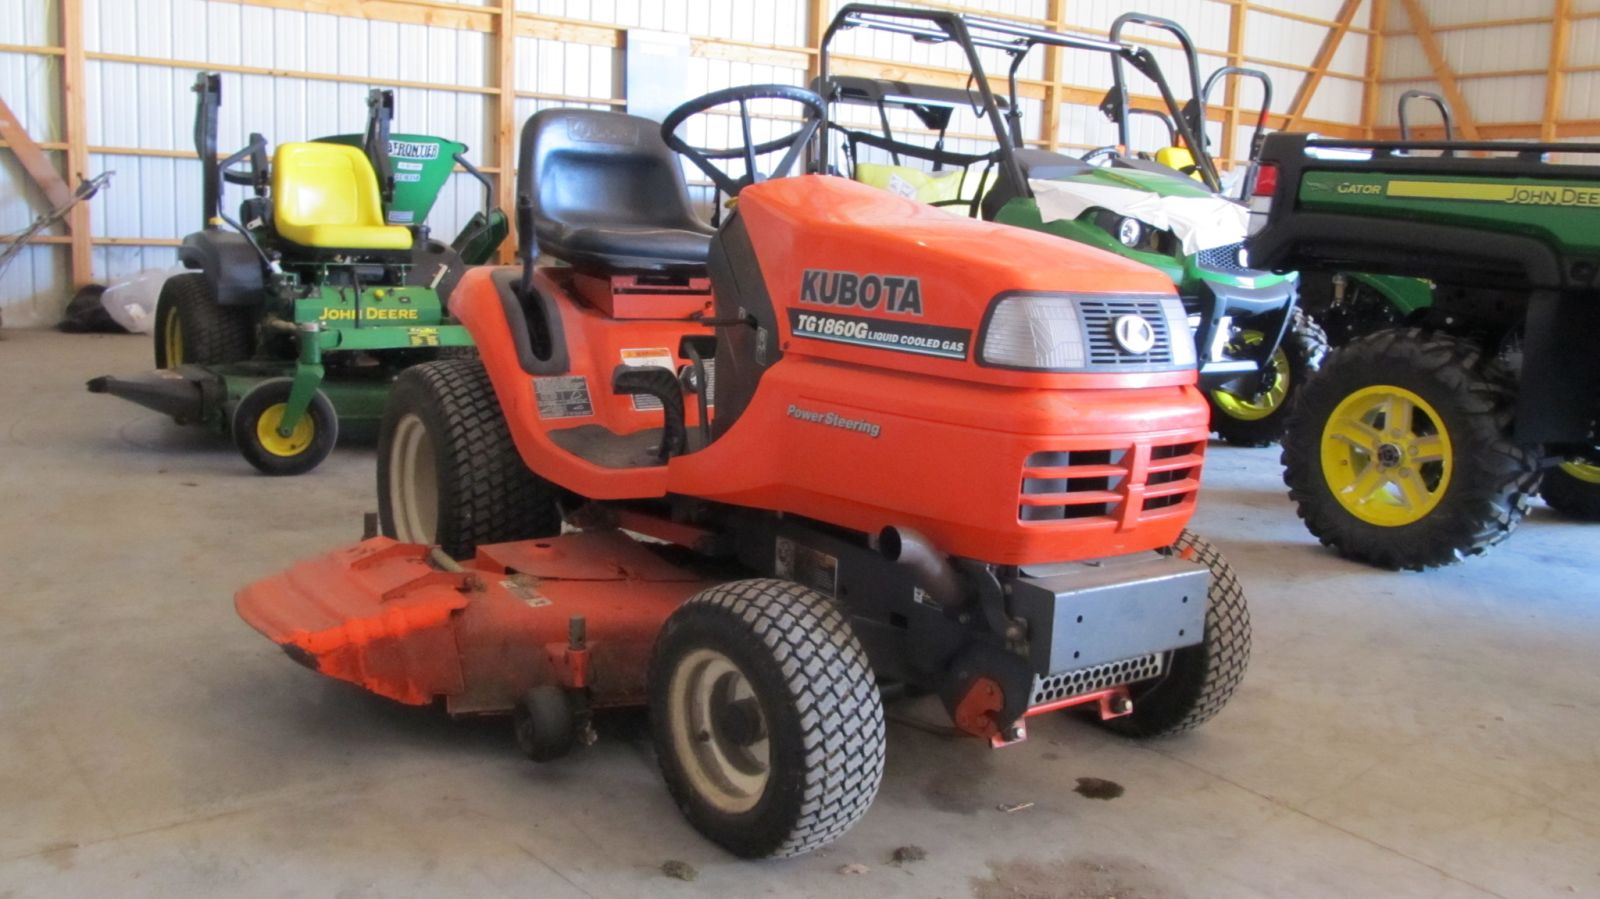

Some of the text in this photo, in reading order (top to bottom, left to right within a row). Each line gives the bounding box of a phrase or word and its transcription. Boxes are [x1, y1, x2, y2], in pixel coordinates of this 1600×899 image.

[393, 142, 438, 158] FRONTIER
[1337, 182, 1381, 194] GATOR
[1505, 187, 1558, 204] JOHN
[801, 269, 922, 315] KUBOTA
[366, 307, 418, 320] DEERE
[797, 314, 965, 352] TG1860G LIQUID COOLED GAS
